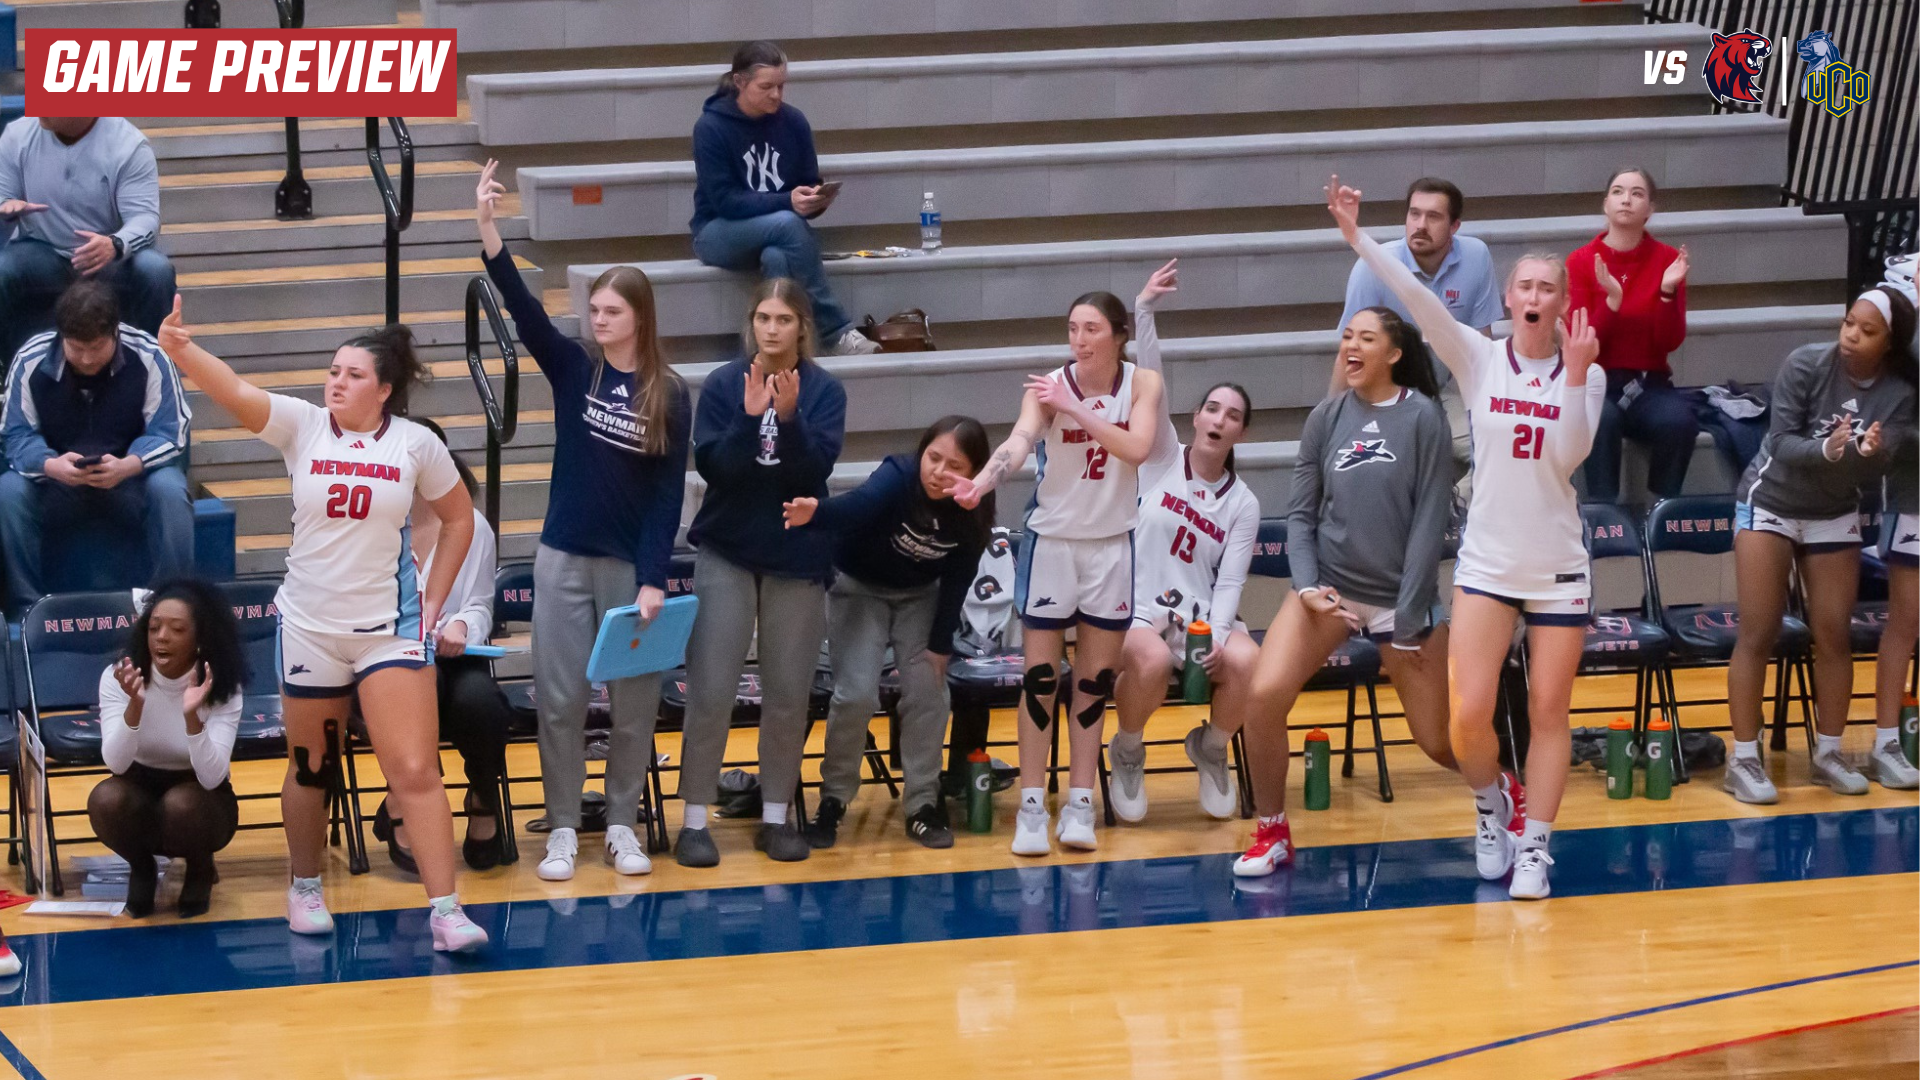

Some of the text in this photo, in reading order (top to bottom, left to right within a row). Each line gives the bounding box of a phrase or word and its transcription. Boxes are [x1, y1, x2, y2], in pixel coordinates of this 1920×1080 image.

[742, 141, 785, 192] NY
[586, 406, 647, 436] NEWMAN
[1512, 423, 1545, 461] 21
[310, 459, 401, 483] NEWMAN
[1081, 445, 1109, 480] 12
[326, 483, 373, 521] 20
[1666, 518, 1736, 533] NEWM
[1169, 525, 1197, 564] 13
[1595, 640, 1639, 651] JETS
[1648, 742, 1662, 759] G
[975, 773, 990, 792] G
